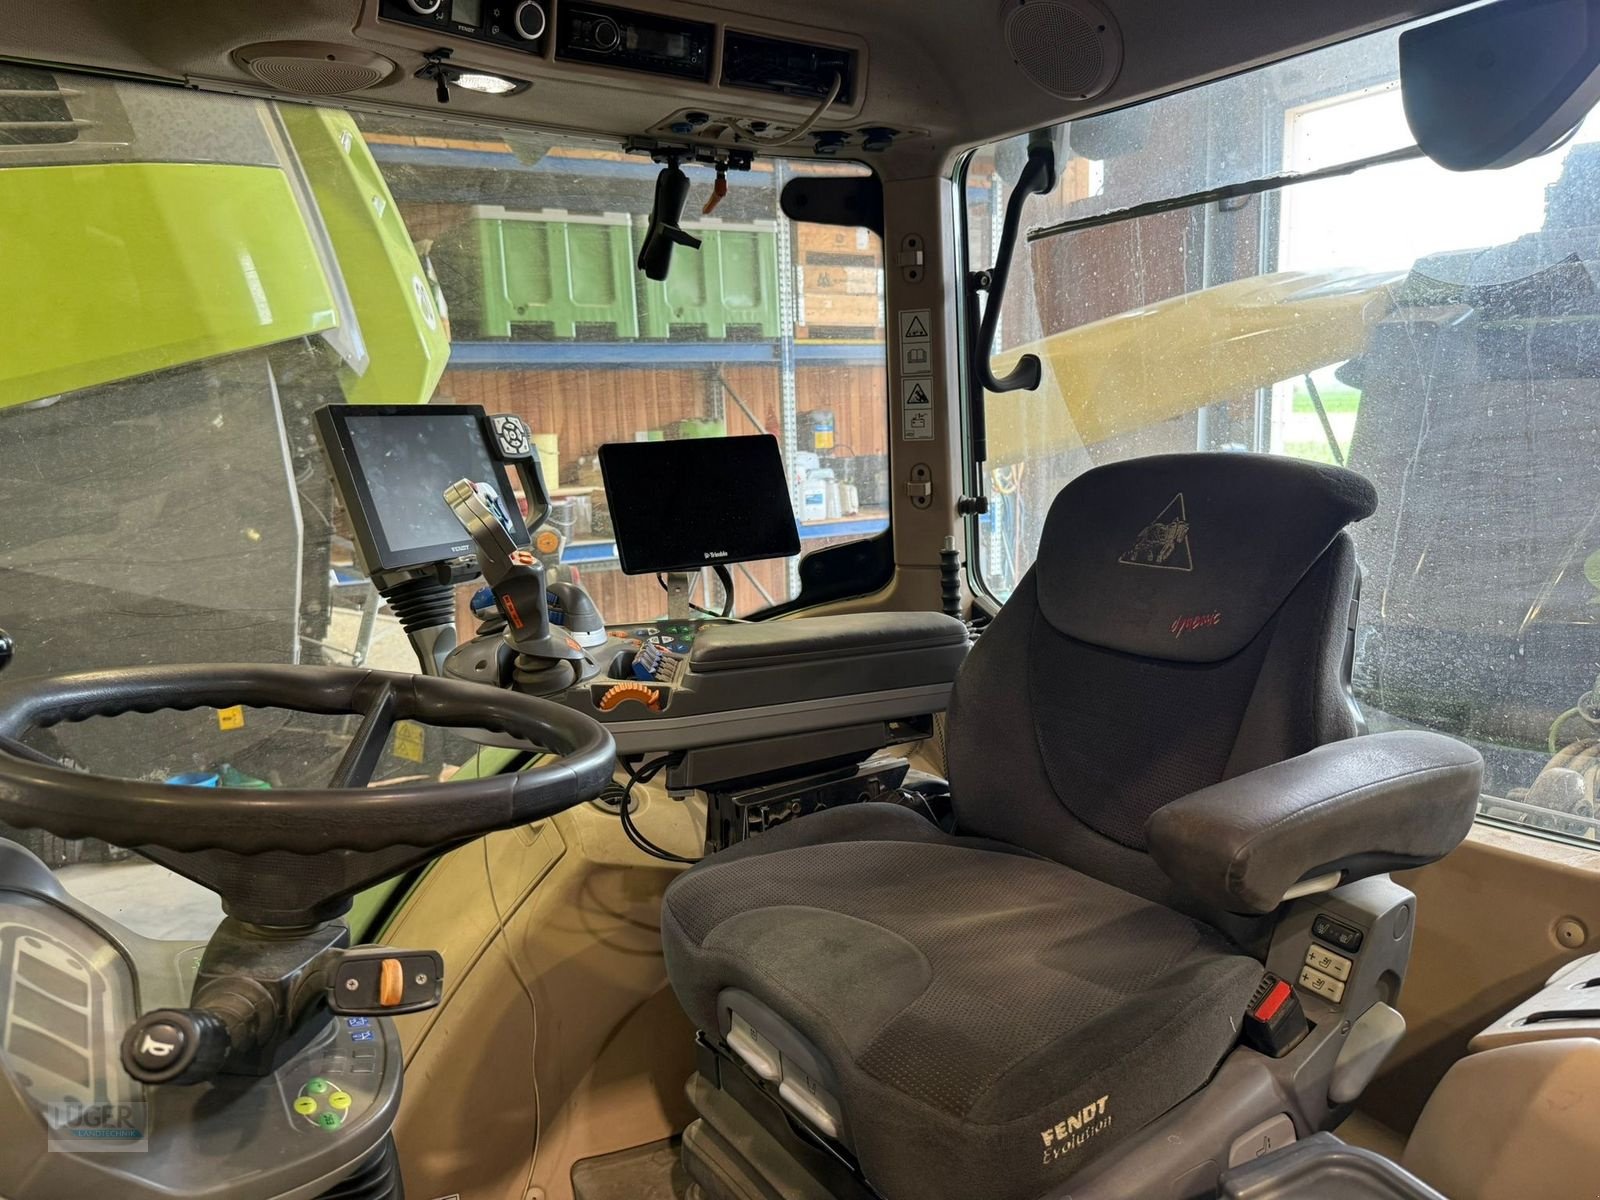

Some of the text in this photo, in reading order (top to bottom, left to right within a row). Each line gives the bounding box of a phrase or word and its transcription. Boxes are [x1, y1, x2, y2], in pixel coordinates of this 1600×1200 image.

[709, 550, 728, 558] Trimble
[1041, 1095, 1109, 1146] FENDT
[1042, 1115, 1112, 1164] Evolution
